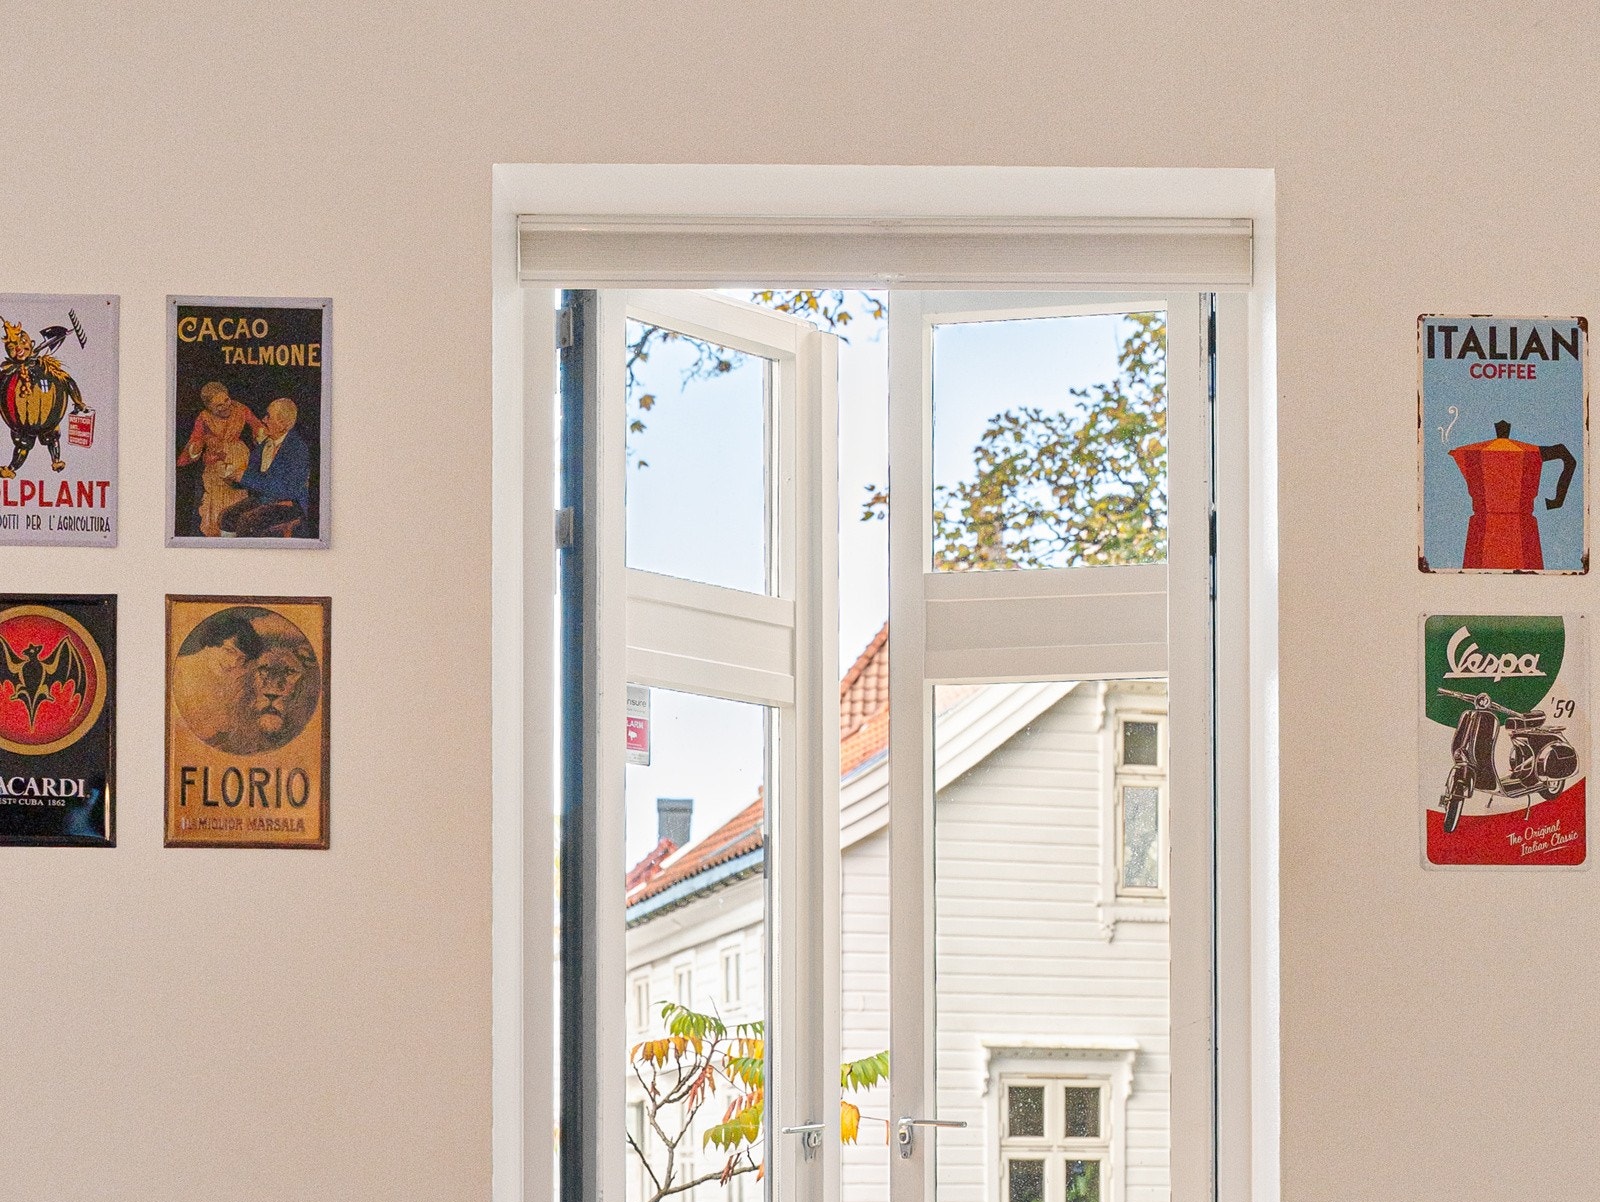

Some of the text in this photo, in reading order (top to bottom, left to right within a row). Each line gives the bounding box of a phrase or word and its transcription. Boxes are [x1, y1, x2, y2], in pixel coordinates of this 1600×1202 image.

[177, 316, 269, 342] CACAO
[221, 343, 321, 367] TALMONE
[1426, 325, 1580, 361] ITALIAN
[1469, 363, 1537, 380] COFFEE
[0, 479, 110, 508] LPLANT
[26, 514, 42, 531] PER
[1442, 625, 1548, 682] Vespa
[1550, 697, 1576, 719] '59
[180, 766, 310, 809] FLORIO
[18, 798, 44, 807] CUBA
[47, 799, 66, 807] 1862
[249, 817, 306, 832] MARSALA
[1506, 819, 1561, 846] The Original
[1521, 830, 1579, 857] Italian Classic
